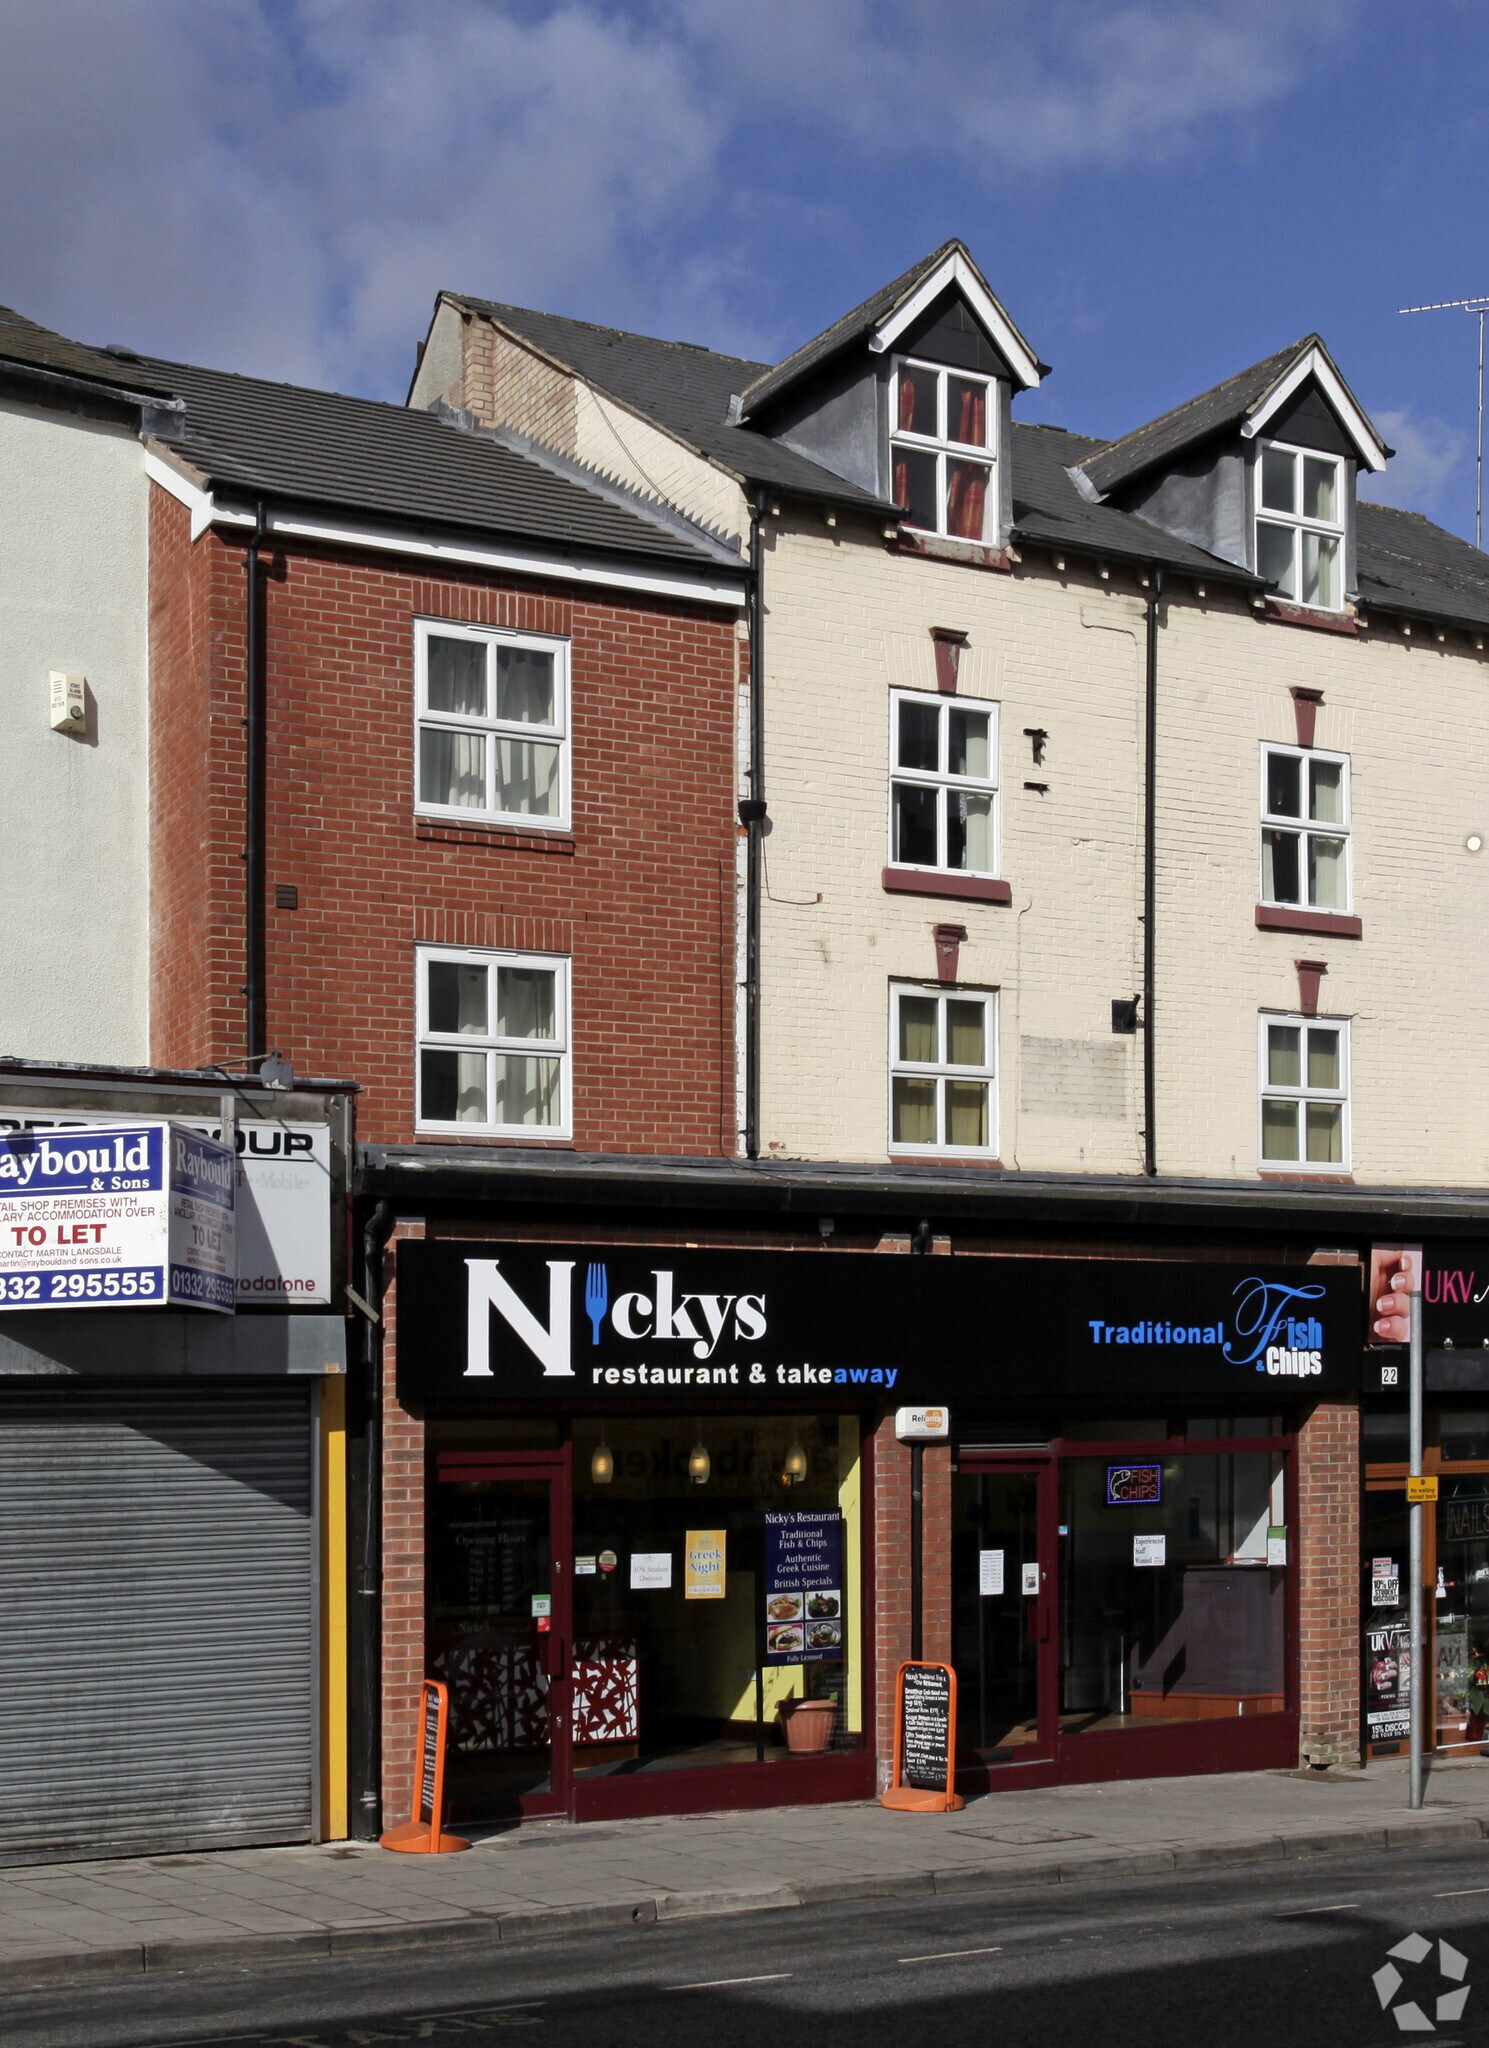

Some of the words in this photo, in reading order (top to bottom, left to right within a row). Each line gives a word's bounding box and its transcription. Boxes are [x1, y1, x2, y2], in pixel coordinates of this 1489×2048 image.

[175, 1138, 231, 1190] Raybould
[91, 1177, 104, 1191] &
[111, 1176, 150, 1190] Sons
[20, 1201, 49, 1211] SHOP
[53, 1198, 106, 1209] PREMISES
[110, 1197, 137, 1207] WITH
[27, 1208, 122, 1221] ACCOMMODATION
[125, 1207, 155, 1217] OVER
[11, 1226, 47, 1246] TO
[57, 1223, 107, 1245] LET
[192, 1225, 205, 1246] TO
[207, 1229, 222, 1251] LET
[36, 1249, 68, 1258] MARTIN
[71, 1247, 122, 1256] LANGSDALE
[0, 1257, 77, 1270] artin@raybouldand
[51, 1272, 156, 1299] 295555
[172, 1270, 203, 1296] 01332
[205, 1276, 233, 1304] 295555
[1425, 1270, 1475, 1303] UKV
[1089, 1320, 1223, 1344] Traditional
[1255, 1359, 1265, 1372] &
[1266, 1345, 1322, 1377] Chips
[592, 1363, 740, 1385] restaurant
[748, 1362, 767, 1385] &
[776, 1362, 898, 1388] takeaway
[1383, 1369, 1396, 1382] 22
[1131, 1469, 1158, 1483] FISH
[1120, 1485, 1158, 1500] CHIPS
[765, 1513, 795, 1526] Nicky's
[797, 1512, 840, 1522] Restaurant
[456, 1534, 496, 1548] Opening
[498, 1533, 527, 1543] Hours
[781, 1529, 823, 1539] Traditional
[779, 1540, 795, 1549] Fish
[797, 1540, 803, 1548] &
[806, 1539, 827, 1549] Chips
[689, 1549, 722, 1559] Greek
[785, 1554, 821, 1563] Authentic
[690, 1561, 720, 1574] Night
[777, 1564, 799, 1573] Greek
[802, 1563, 830, 1571] Cuisine
[774, 1578, 800, 1588] British
[802, 1577, 833, 1588] Specials
[1372, 1724, 1384, 1733] 15%
[1385, 1722, 1410, 1732] DISCOUN
